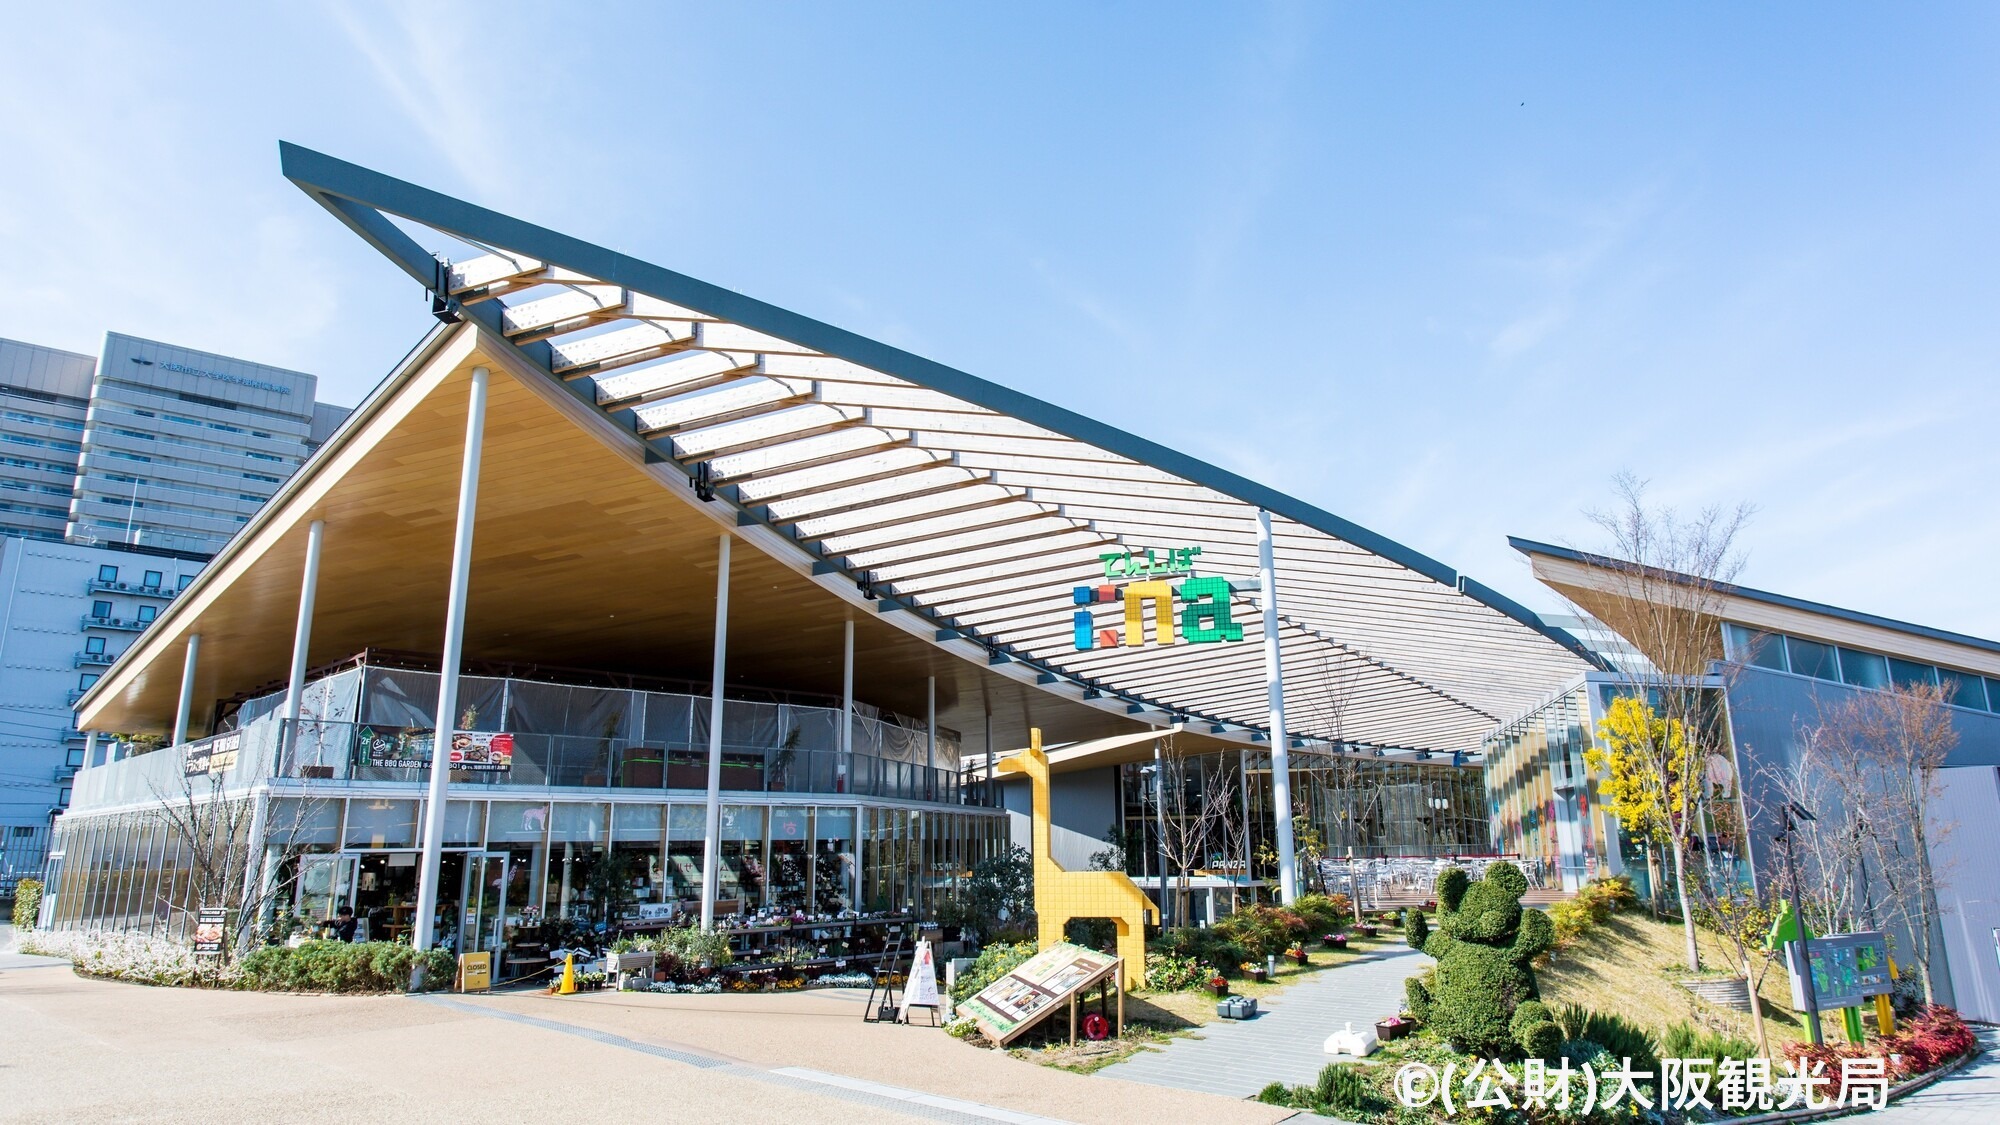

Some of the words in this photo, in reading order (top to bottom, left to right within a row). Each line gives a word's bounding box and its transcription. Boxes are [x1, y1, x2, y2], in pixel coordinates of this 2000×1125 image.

[1099, 546, 1202, 578] てんしば
[372, 759, 383, 767] THE
[398, 760, 422, 768] GARDEN
[1211, 860, 1246, 869] PANZA
